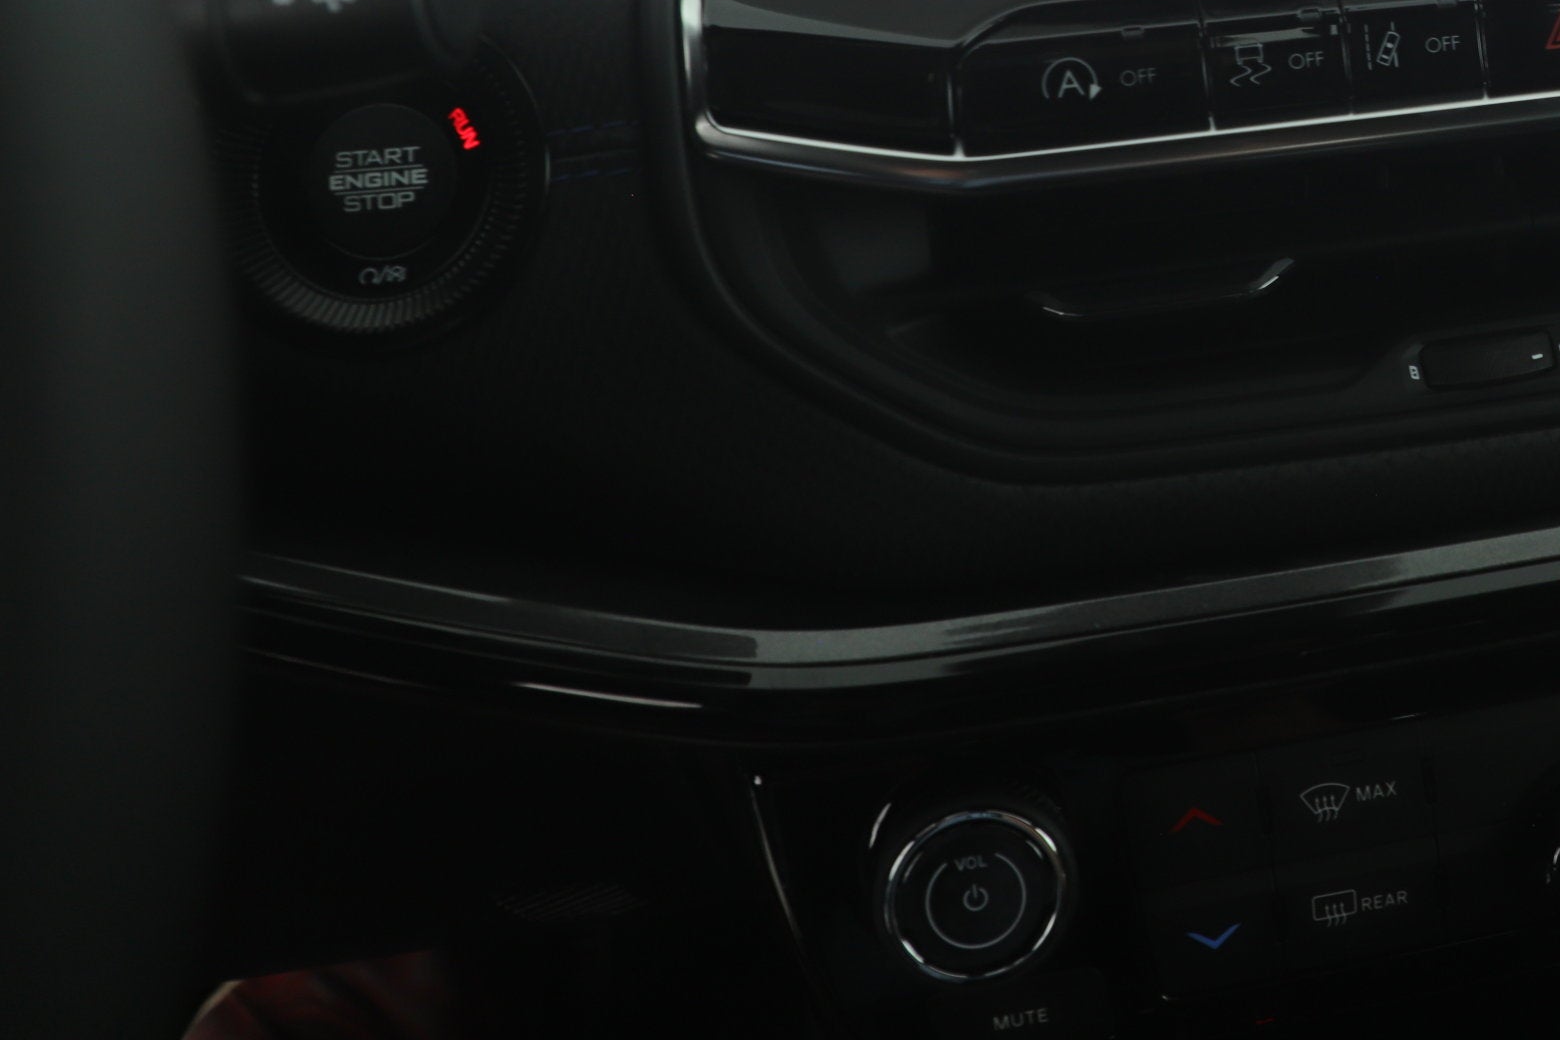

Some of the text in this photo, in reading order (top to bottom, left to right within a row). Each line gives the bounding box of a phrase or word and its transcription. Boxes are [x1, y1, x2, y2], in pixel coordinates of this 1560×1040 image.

[1424, 34, 1463, 54] OFF
[1287, 50, 1326, 71] OFF
[1119, 66, 1158, 88] OFF
[447, 106, 481, 151] RUN
[335, 145, 422, 169] START
[328, 168, 430, 191] ENGINE
[343, 190, 416, 214] STOP
[1355, 779, 1398, 802] MAX
[954, 854, 988, 872] VOL
[1359, 890, 1409, 912] REAR
[992, 1007, 1050, 1032] MUTE
